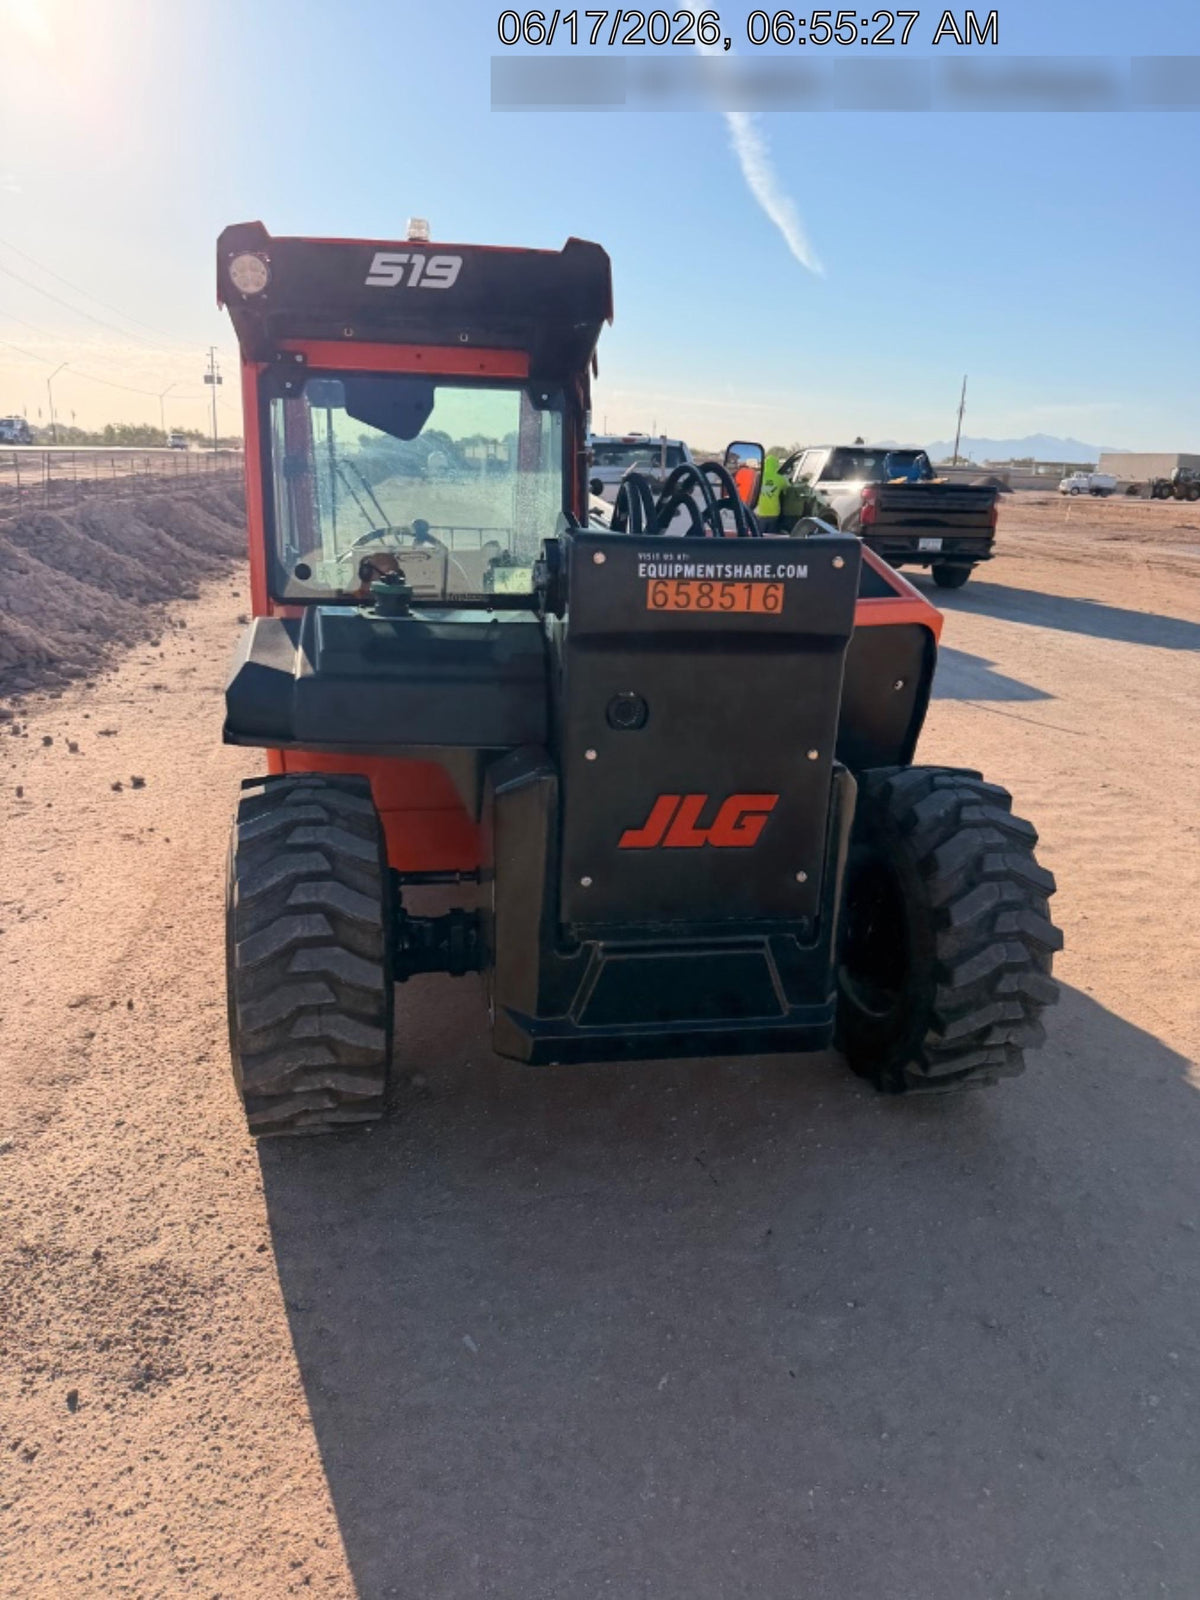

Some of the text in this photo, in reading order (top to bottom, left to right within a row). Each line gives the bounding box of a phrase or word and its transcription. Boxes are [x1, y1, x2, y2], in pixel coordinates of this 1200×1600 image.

[364, 252, 463, 289] 519
[638, 563, 808, 579] EQUIPMENTSHARE.COM
[651, 580, 780, 611] 658516
[617, 794, 780, 848] JLG
